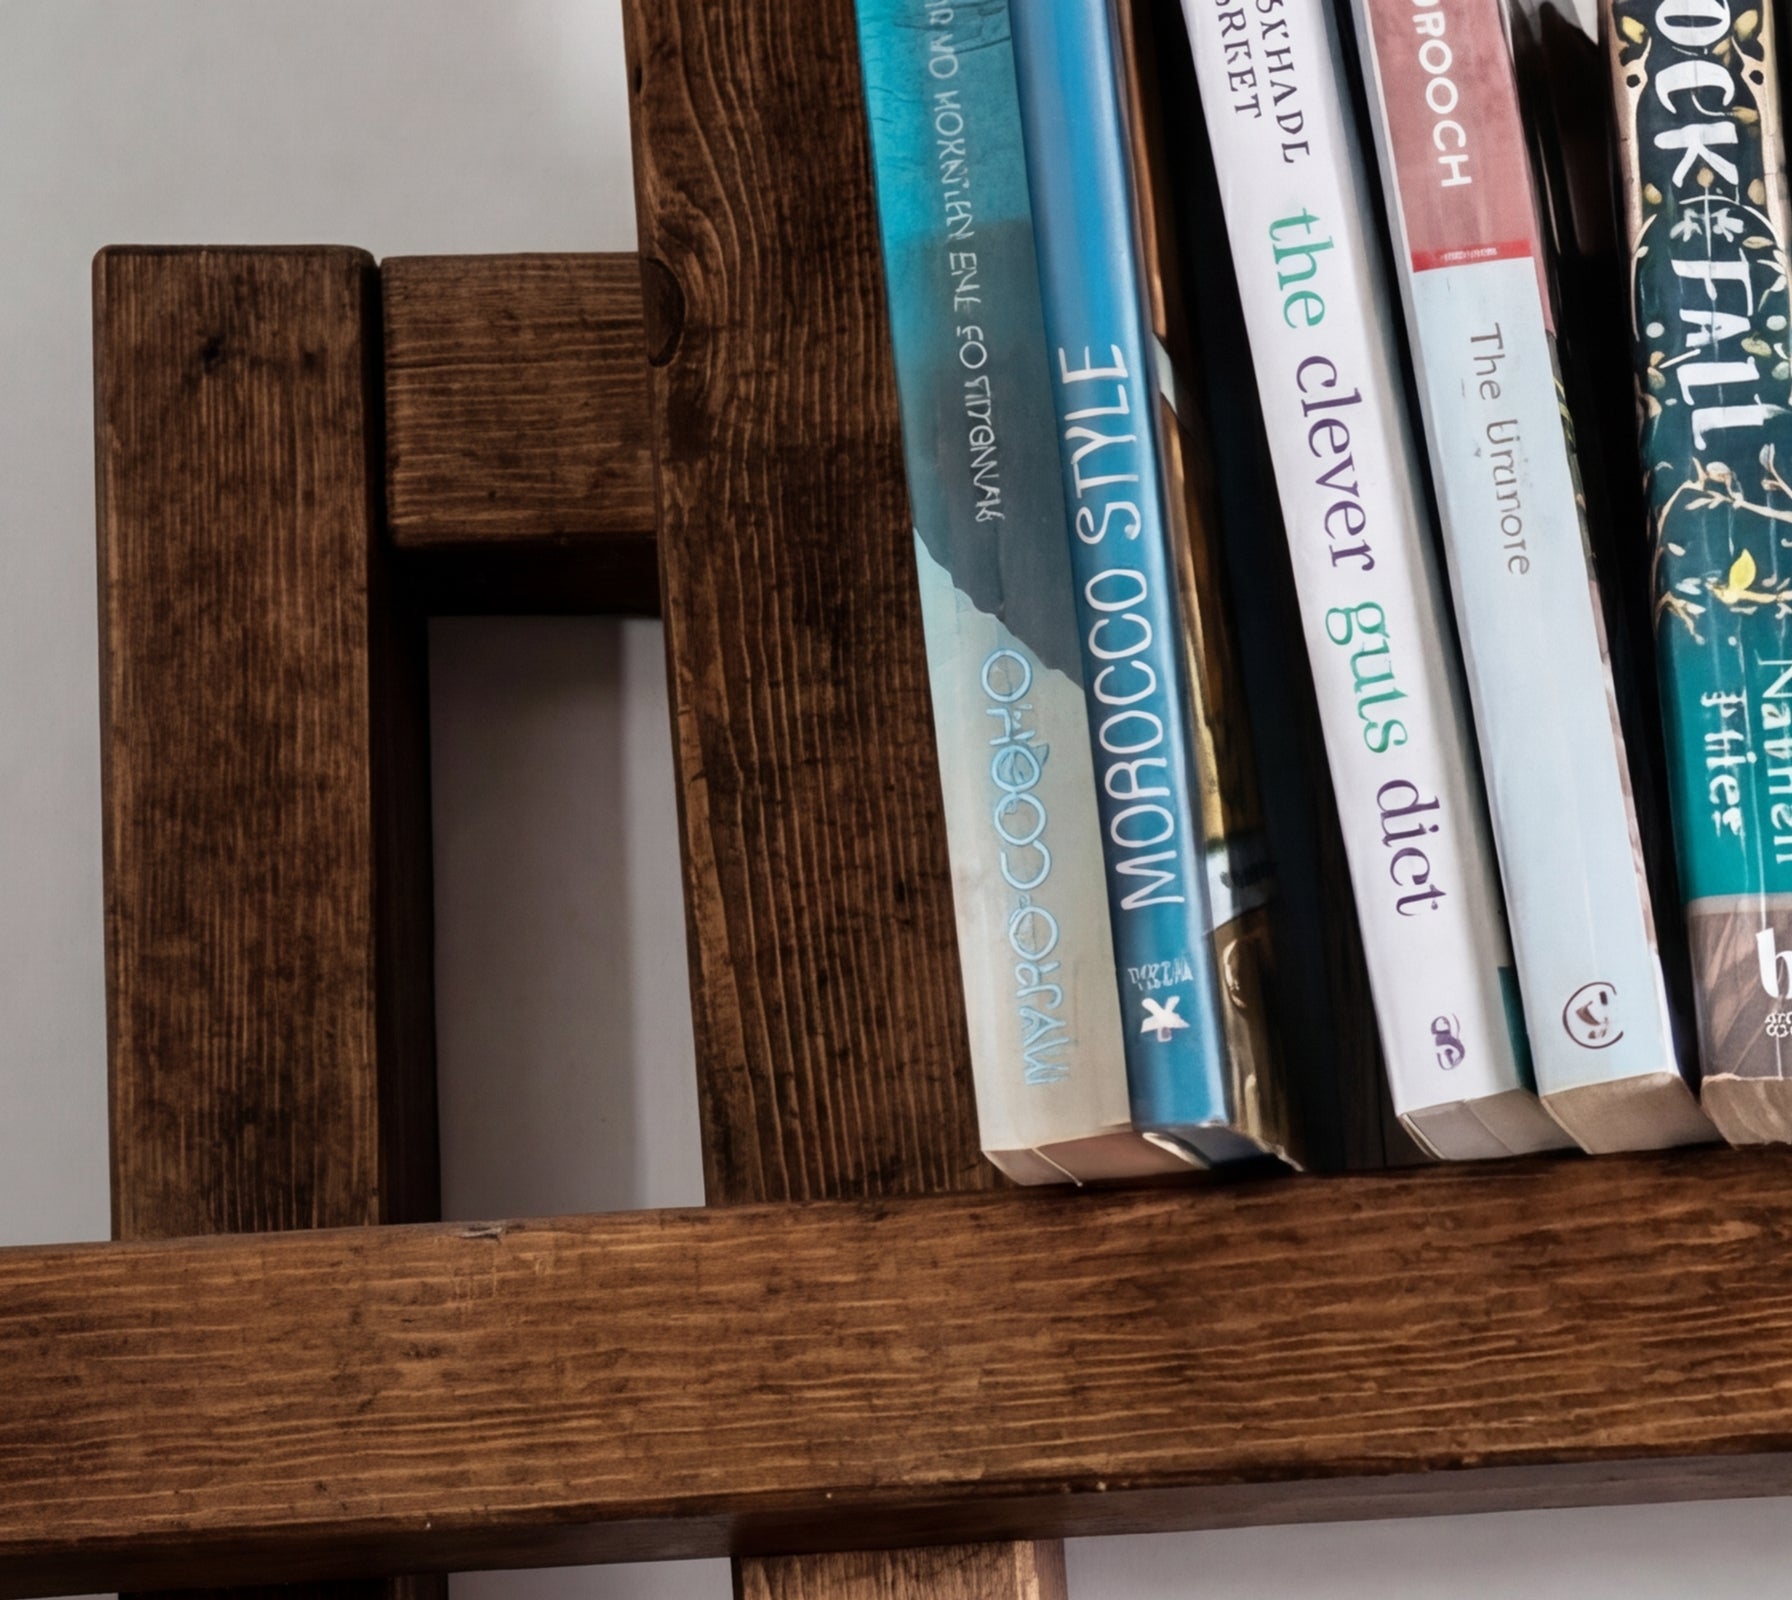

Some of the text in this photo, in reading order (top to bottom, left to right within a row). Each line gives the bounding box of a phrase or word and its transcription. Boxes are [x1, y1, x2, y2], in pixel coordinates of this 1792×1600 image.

[1267, 207, 1336, 330] the
[1470, 322, 1506, 401] The
[1058, 343, 1142, 544] STYLE
[1295, 354, 1377, 571] clever
[1085, 566, 1184, 912] MOROCCO
